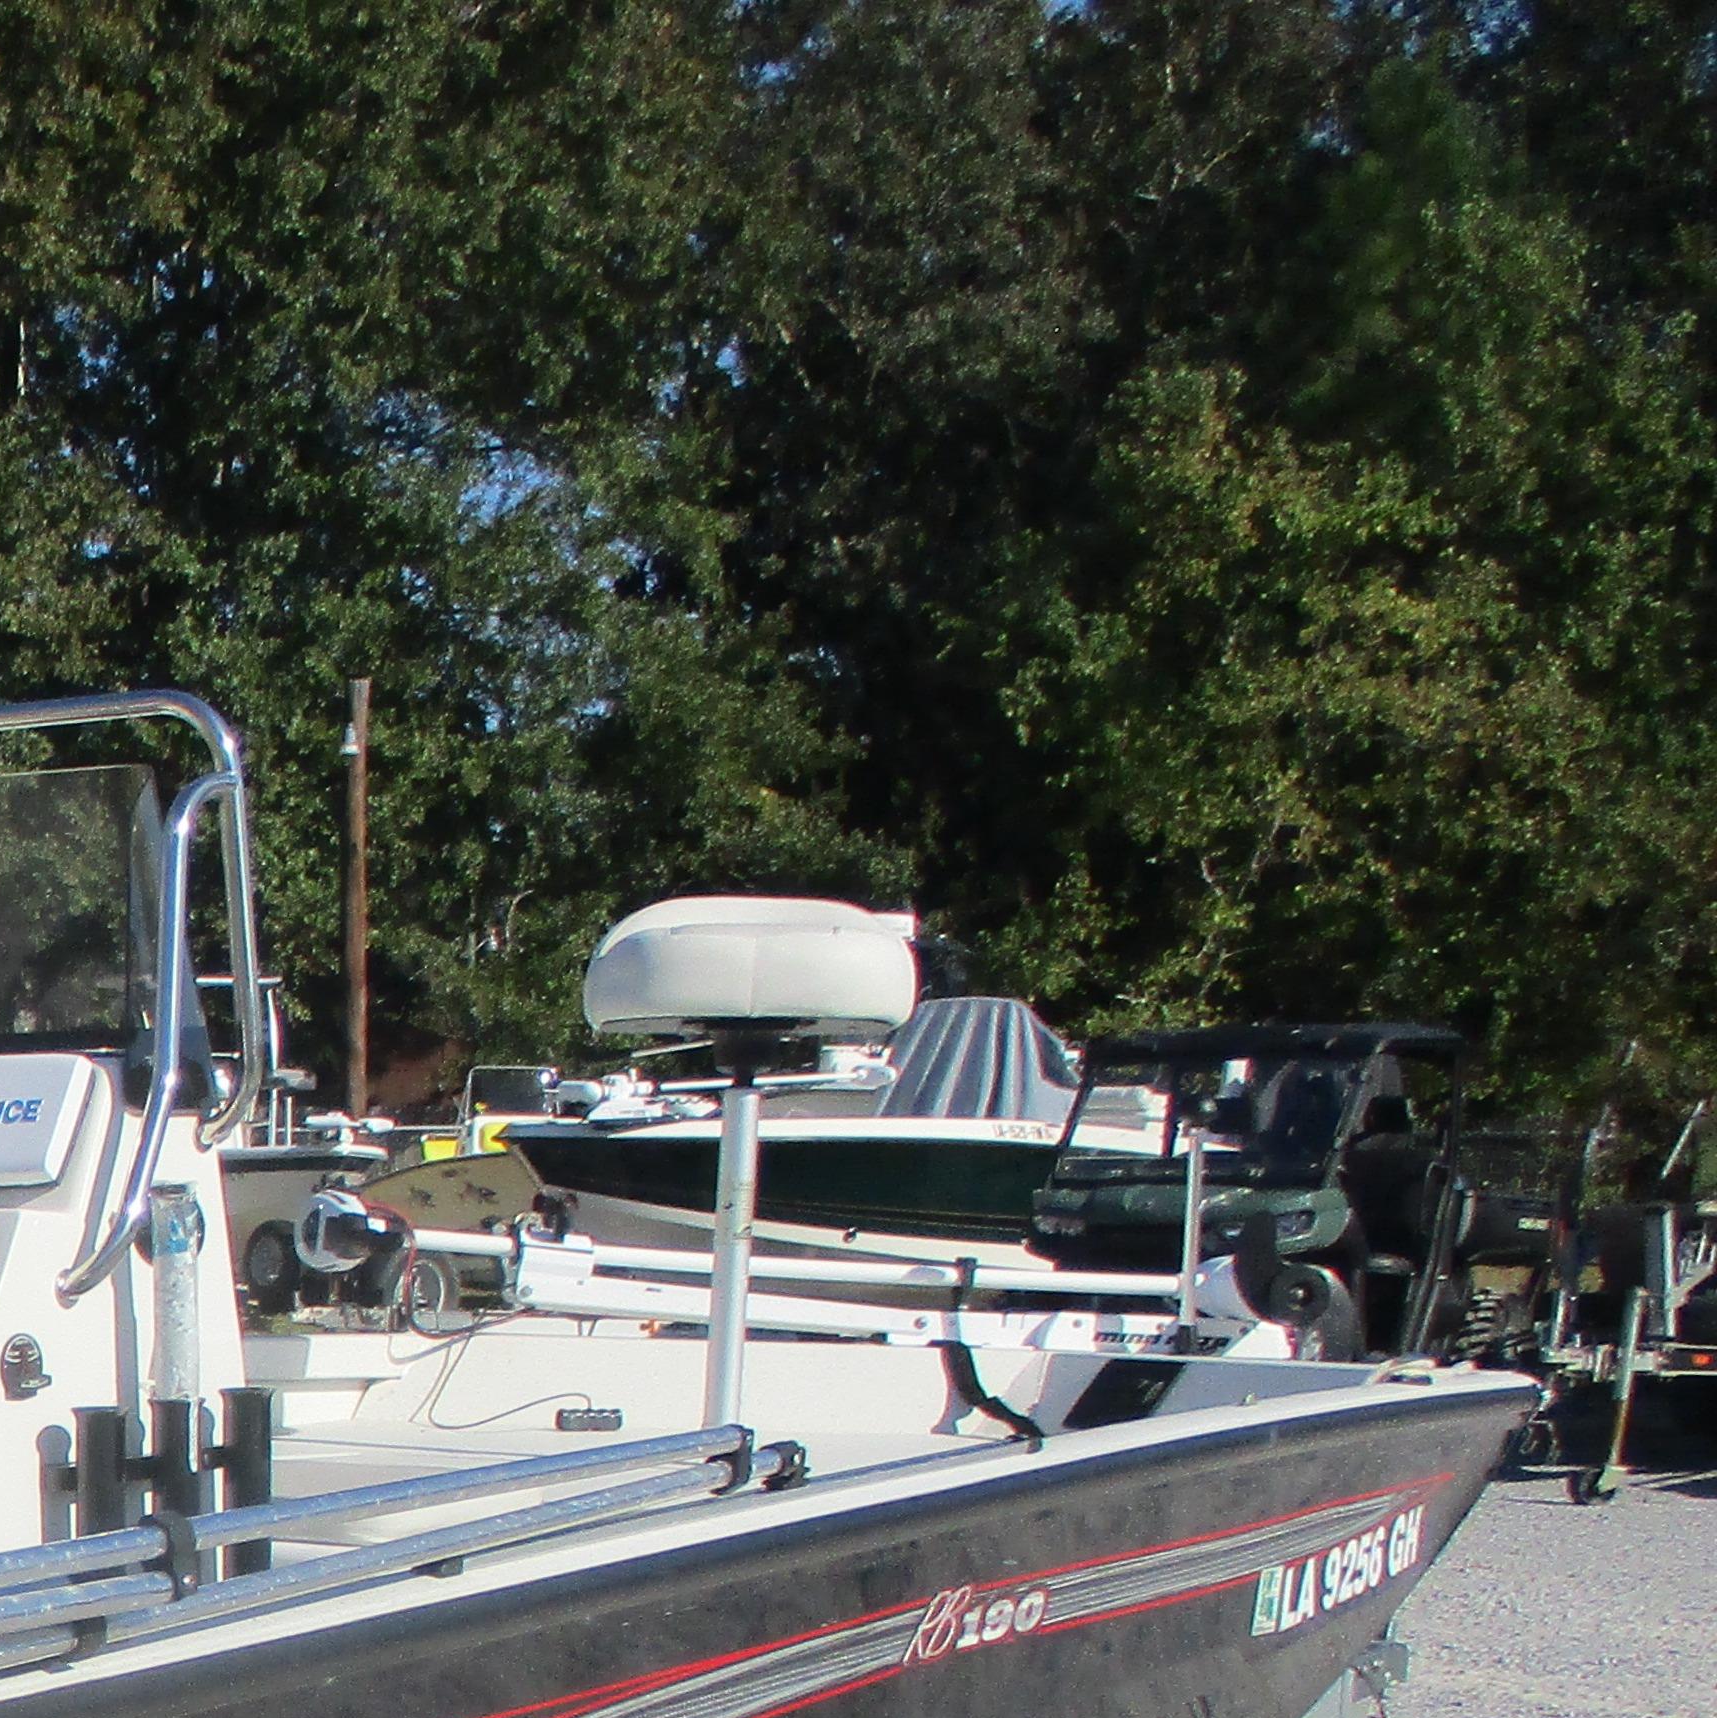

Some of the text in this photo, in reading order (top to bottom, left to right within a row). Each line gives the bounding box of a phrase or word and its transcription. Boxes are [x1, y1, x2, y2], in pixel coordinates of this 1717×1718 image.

[1278, 1556, 1316, 1634] LA
[1319, 1524, 1387, 1611] 9256
[1387, 1503, 1426, 1578] GH
[955, 1589, 1047, 1650] 190
